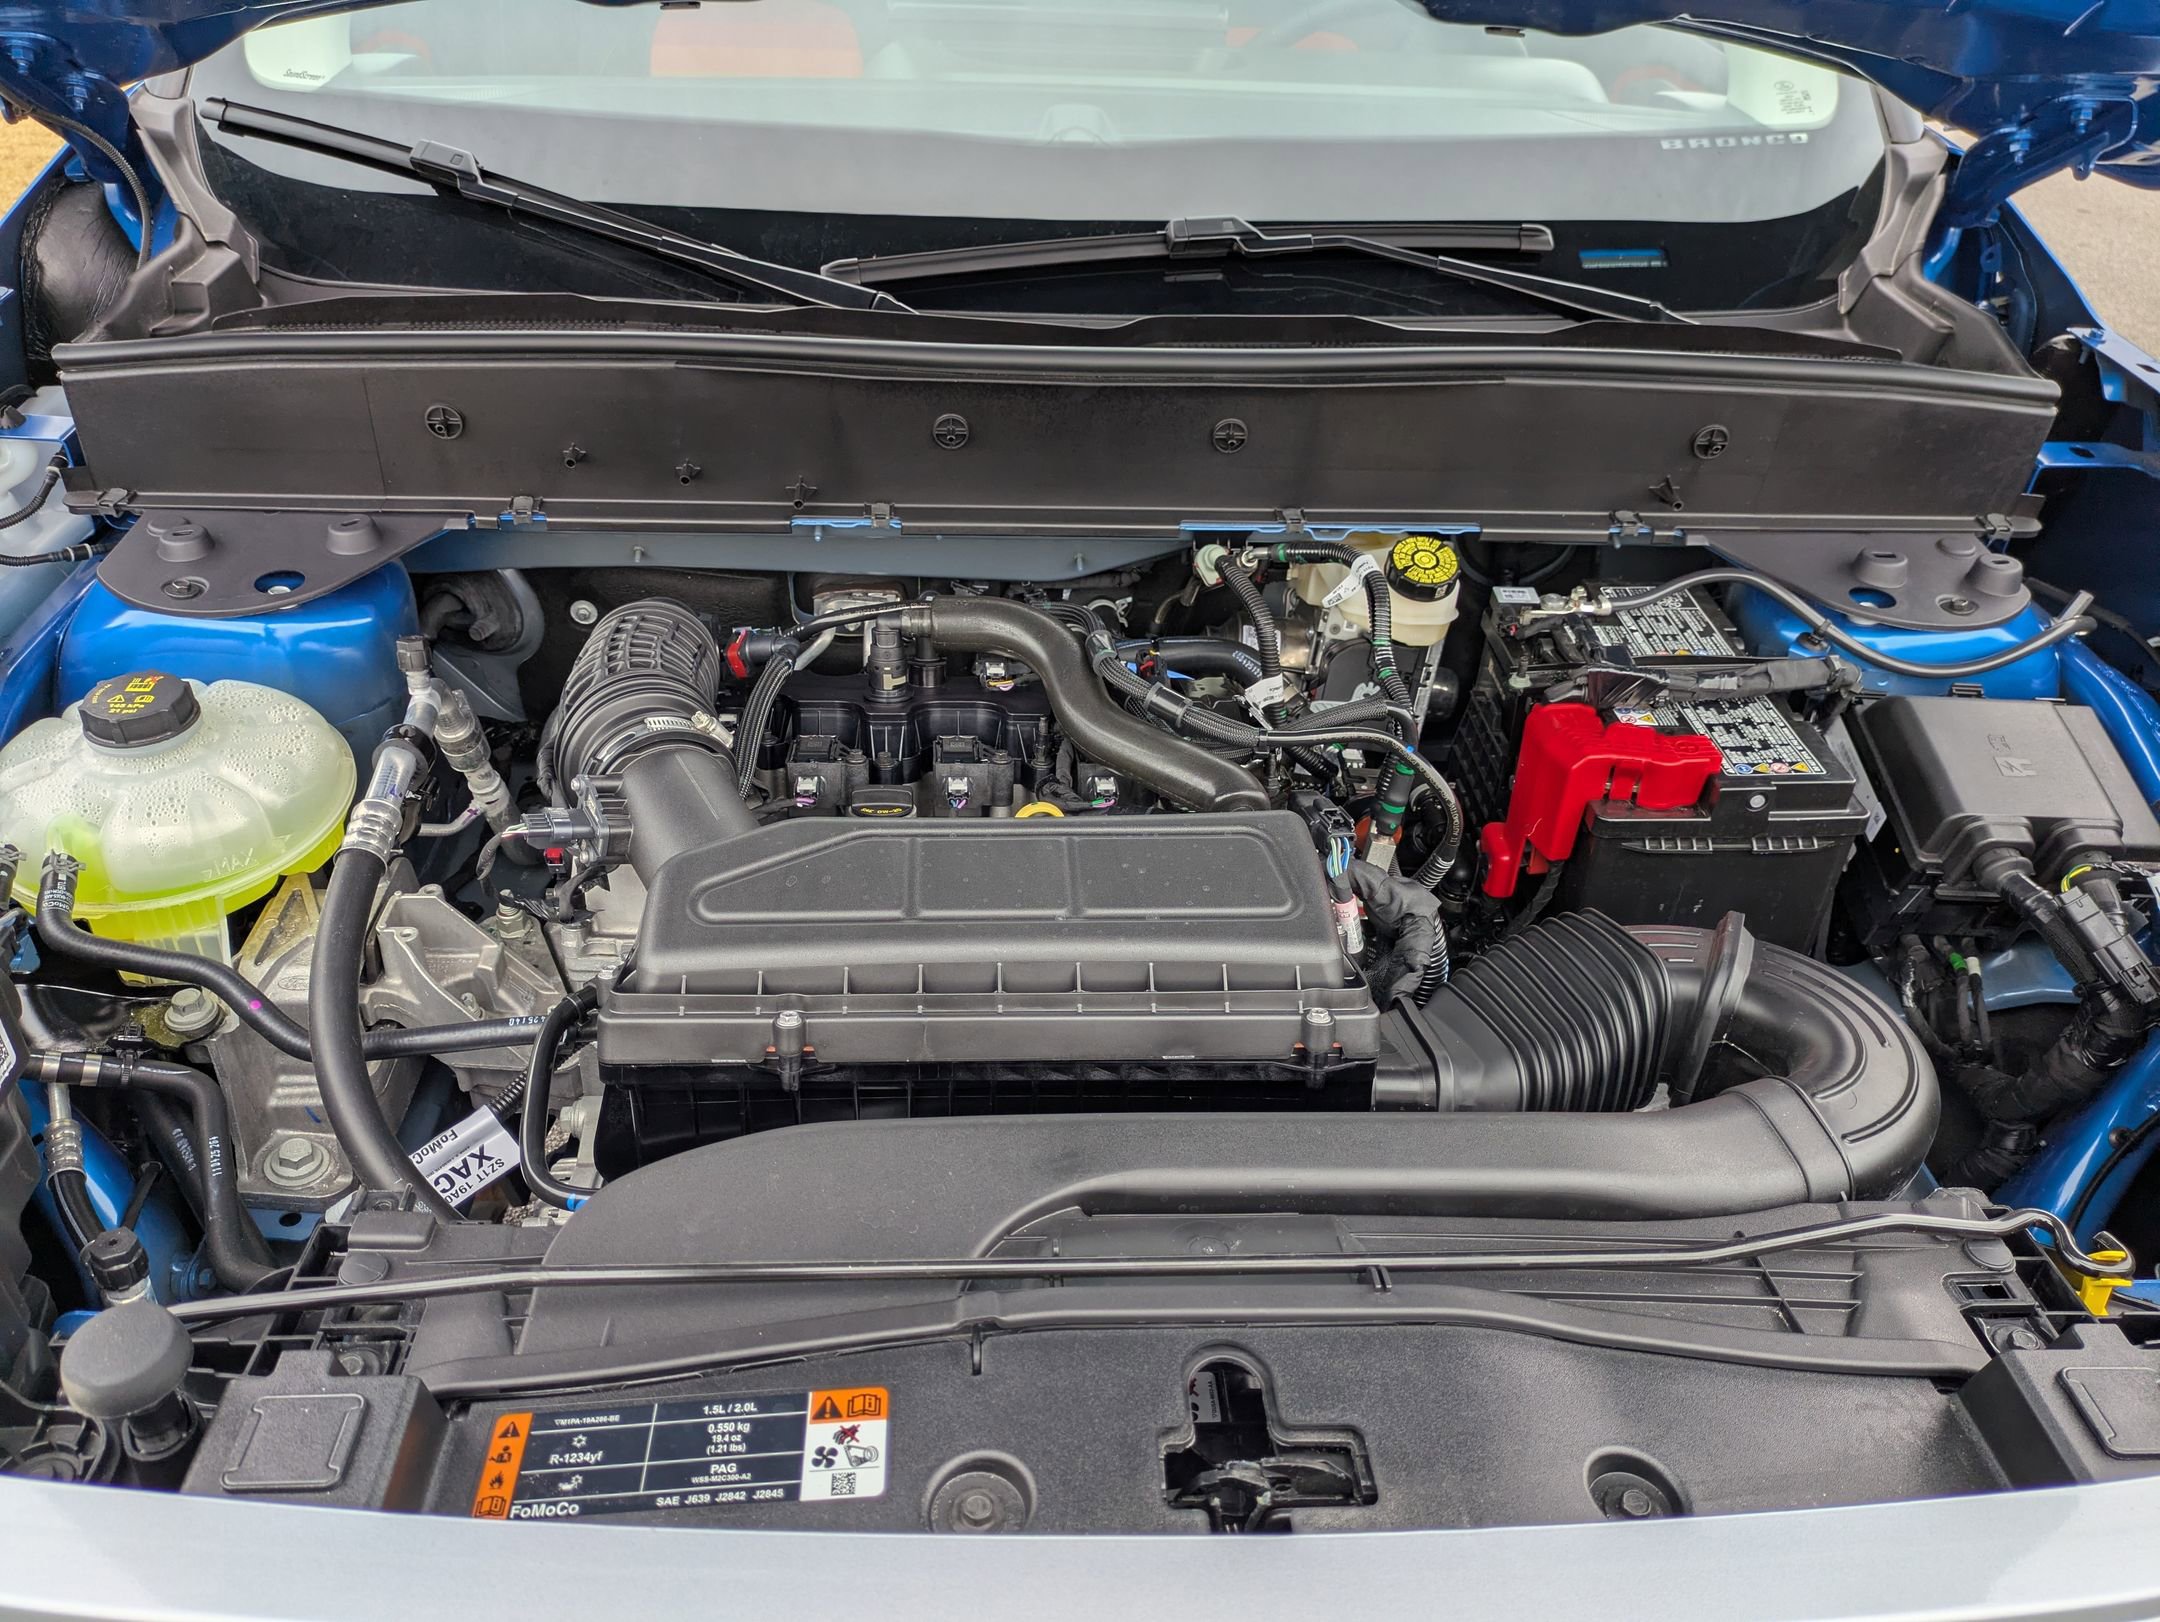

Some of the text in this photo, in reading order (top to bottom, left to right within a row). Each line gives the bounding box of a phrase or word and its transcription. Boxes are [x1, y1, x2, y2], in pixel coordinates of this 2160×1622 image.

[1661, 133, 1808, 150] BRONCO
[43, 901, 70, 910] oMoCo
[412, 1129, 459, 1165] FoMoC
[434, 1144, 495, 1194] XAC
[476, 1158, 505, 1183] SZ1T
[703, 1404, 726, 1415] 1.5L
[734, 1402, 758, 1413] 2.0L
[707, 1421, 751, 1433] 0.550 kg
[711, 1433, 742, 1443] 19.4 oz
[706, 1442, 746, 1456] (1.21 lbs)
[548, 1450, 603, 1465] R-1234yf
[710, 1463, 737, 1474] PAG
[656, 1488, 784, 1506] SAE J639 J2842 J2845
[509, 1501, 580, 1519] FoMoCo
